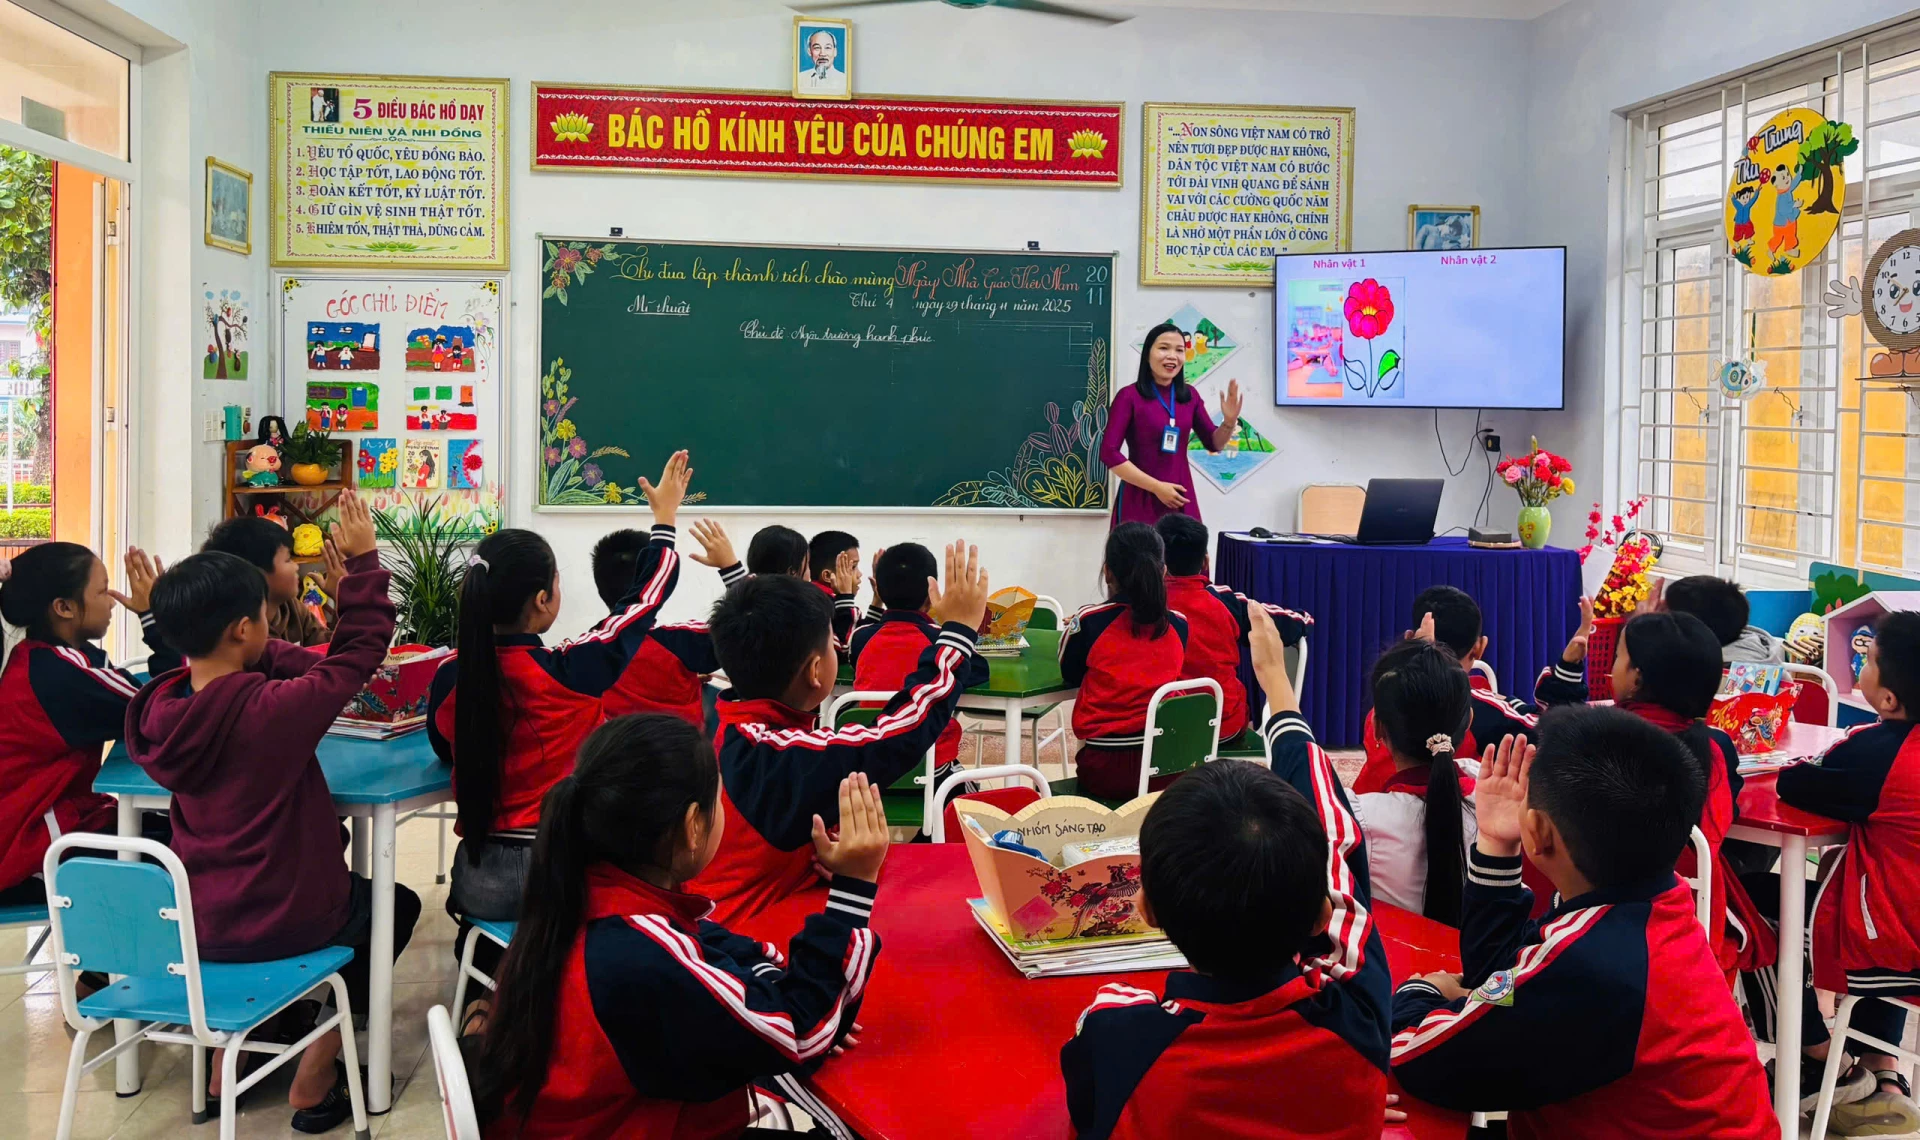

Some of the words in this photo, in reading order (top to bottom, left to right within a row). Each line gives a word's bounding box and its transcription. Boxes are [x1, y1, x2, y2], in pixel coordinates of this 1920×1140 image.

[353, 98, 372, 120] 5
[378, 97, 406, 119] ĐIỀU
[410, 100, 436, 120] BÁC
[440, 98, 456, 120] HỒ
[460, 104, 484, 124] DẠY
[302, 124, 344, 134] THIẾU
[350, 126, 382, 136] NIÊN
[388, 126, 408, 136] VÀ
[412, 129, 436, 137] NHI
[440, 126, 482, 138] ĐỒNG
[607, 108, 664, 150] BÁC
[674, 107, 712, 151] HỒ
[720, 111, 785, 154] KÍNH
[794, 114, 845, 156] YÊU
[853, 112, 907, 158] CỦA
[915, 118, 1005, 161] CHÚNG
[1013, 127, 1054, 162] EM
[1210, 124, 1238, 138] SÔNG
[1242, 126, 1265, 140] VIỆT
[1268, 129, 1290, 139] NAM
[1293, 126, 1306, 139] CÓ
[1309, 126, 1330, 140] TRỞ
[1759, 120, 1803, 154] Trung
[296, 148, 305, 157] 1.
[307, 146, 334, 161] YÊU
[337, 143, 354, 158] TỔ
[356, 145, 392, 161] QUỐC,
[395, 147, 419, 160] YÊU
[422, 146, 456, 161] ĐỒNG
[459, 148, 486, 162] BÀO.
[1168, 141, 1188, 154] NÊN
[1191, 144, 1215, 154] TƯƠI
[1218, 145, 1238, 157] ĐẸP
[1240, 145, 1268, 157] ĐƯỢC
[1270, 146, 1290, 156] HAY
[1292, 144, 1330, 158] KHÔNG,
[296, 167, 305, 176] 2.
[308, 165, 337, 180] HỌC
[339, 165, 363, 180] TẬP
[366, 163, 392, 180] TỐT,
[396, 169, 419, 179] LAO
[422, 167, 456, 182] ĐỘNG
[459, 166, 486, 180] TỐT.
[1168, 158, 1191, 171] DÂN
[1195, 159, 1218, 173] TỘC
[1222, 160, 1248, 174] VIỆT
[1251, 163, 1276, 172] NAM
[1280, 160, 1295, 173] CÓ
[1299, 161, 1329, 173] BƯỚC
[1734, 158, 1760, 185] Thu
[1168, 174, 1186, 188] TỚI
[1189, 175, 1208, 188] ĐÀI
[1211, 179, 1238, 189] VINH
[1242, 179, 1280, 191] QUANG
[1283, 175, 1297, 190] ĐỂ
[1300, 178, 1329, 190] SÁNH
[296, 187, 305, 196] 3.
[309, 185, 345, 200] ĐOÀN
[348, 183, 372, 197] KẾT
[375, 184, 402, 200] TỐT,
[405, 184, 421, 198] KỶ
[424, 186, 456, 200] LUẬT
[459, 185, 486, 199] TỐT.
[1167, 195, 1186, 204] VAI
[1188, 192, 1206, 205] VỚI
[1209, 194, 1230, 205] CÁC
[1233, 193, 1270, 206] CƯỜNG
[1273, 193, 1302, 208] QUỐC
[1305, 195, 1328, 207] NĂM
[296, 206, 306, 214] 4.
[308, 202, 336, 215] GIỮ
[339, 203, 362, 216] GÌN
[366, 203, 382, 219] VỆ
[386, 206, 416, 217] SINH
[420, 204, 453, 220] THẬT
[457, 203, 485, 218] TỐT.
[1167, 209, 1195, 222] CHÂU
[1198, 212, 1227, 225] ĐƯỢC
[1230, 212, 1250, 223] HAY
[1253, 211, 1293, 225] KHÔNG,
[1296, 212, 1328, 224] CHÍNH
[296, 224, 304, 234] 5.
[306, 221, 344, 237] KHIÊM
[346, 220, 370, 236] TỐN,
[373, 222, 401, 237] THẬT
[402, 224, 426, 237] THÀ,
[428, 224, 457, 236] DŨNG
[460, 222, 485, 237] CẢM.
[1166, 226, 1179, 238] LÀ
[1183, 226, 1205, 239] NHỜ
[1208, 227, 1230, 242] MỘT
[1234, 226, 1262, 240] PHẦN
[1265, 228, 1286, 240] LỚN
[1289, 228, 1297, 240] Ở
[1299, 228, 1328, 240] CÔNG
[1166, 245, 1188, 258] HỌC
[1191, 243, 1210, 257] TẬP
[1213, 242, 1234, 256] CỦA
[1238, 244, 1258, 256] CÁC
[1903, 252, 1910, 260] 12
[1314, 259, 1339, 269] Nhân
[1341, 259, 1357, 270] vật
[1360, 259, 1366, 268] 1
[1441, 255, 1468, 265] Nhân
[1471, 255, 1488, 266] vật
[1490, 255, 1497, 264] 2
[658, 261, 686, 280] đua
[722, 257, 779, 282] thành
[780, 261, 811, 284] tích
[815, 261, 848, 284] chào
[1086, 265, 1108, 282] 20
[1086, 287, 1102, 305] 11
[1877, 288, 1882, 297] 9
[326, 290, 359, 318] GÓC
[363, 286, 397, 312] CHỦ
[405, 288, 448, 319] ĐIỂM
[886, 298, 894, 308] 4
[946, 301, 958, 313] 29
[961, 295, 998, 319] tháng
[1013, 299, 1040, 311] năm
[1042, 298, 1072, 313] 2025
[1881, 304, 1886, 314] 8
[1890, 316, 1896, 326] 7
[1903, 318, 1908, 327] 6
[1018, 821, 1050, 836] NHÓM
[1056, 819, 1085, 837] SÁNG
[1086, 823, 1106, 837] TẠO
